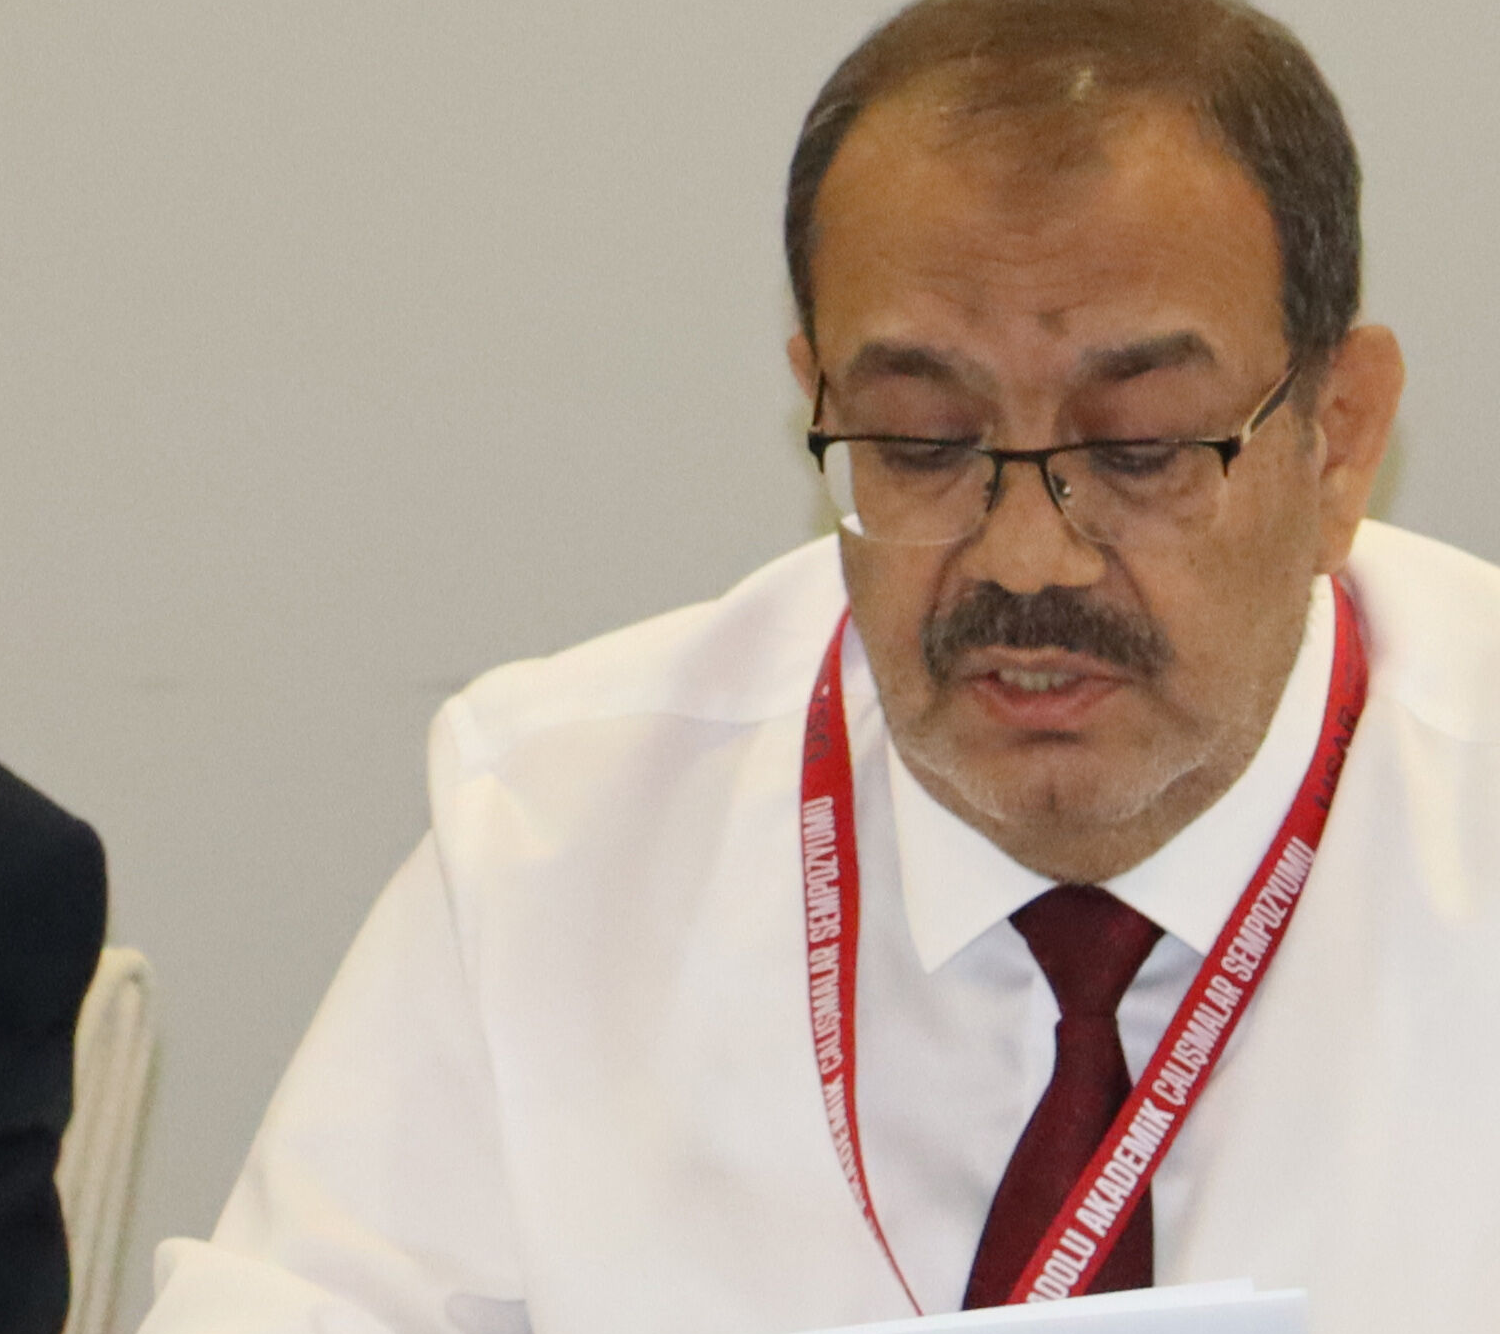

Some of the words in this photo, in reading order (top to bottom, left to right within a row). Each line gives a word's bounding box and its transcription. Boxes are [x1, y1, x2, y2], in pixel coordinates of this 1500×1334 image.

[803, 795, 842, 945] SEMPOZYUMU
[1151, 973, 1243, 1109] ÇALIŞMALAR
[1219, 835, 1317, 982] SEMPOZYUMU
